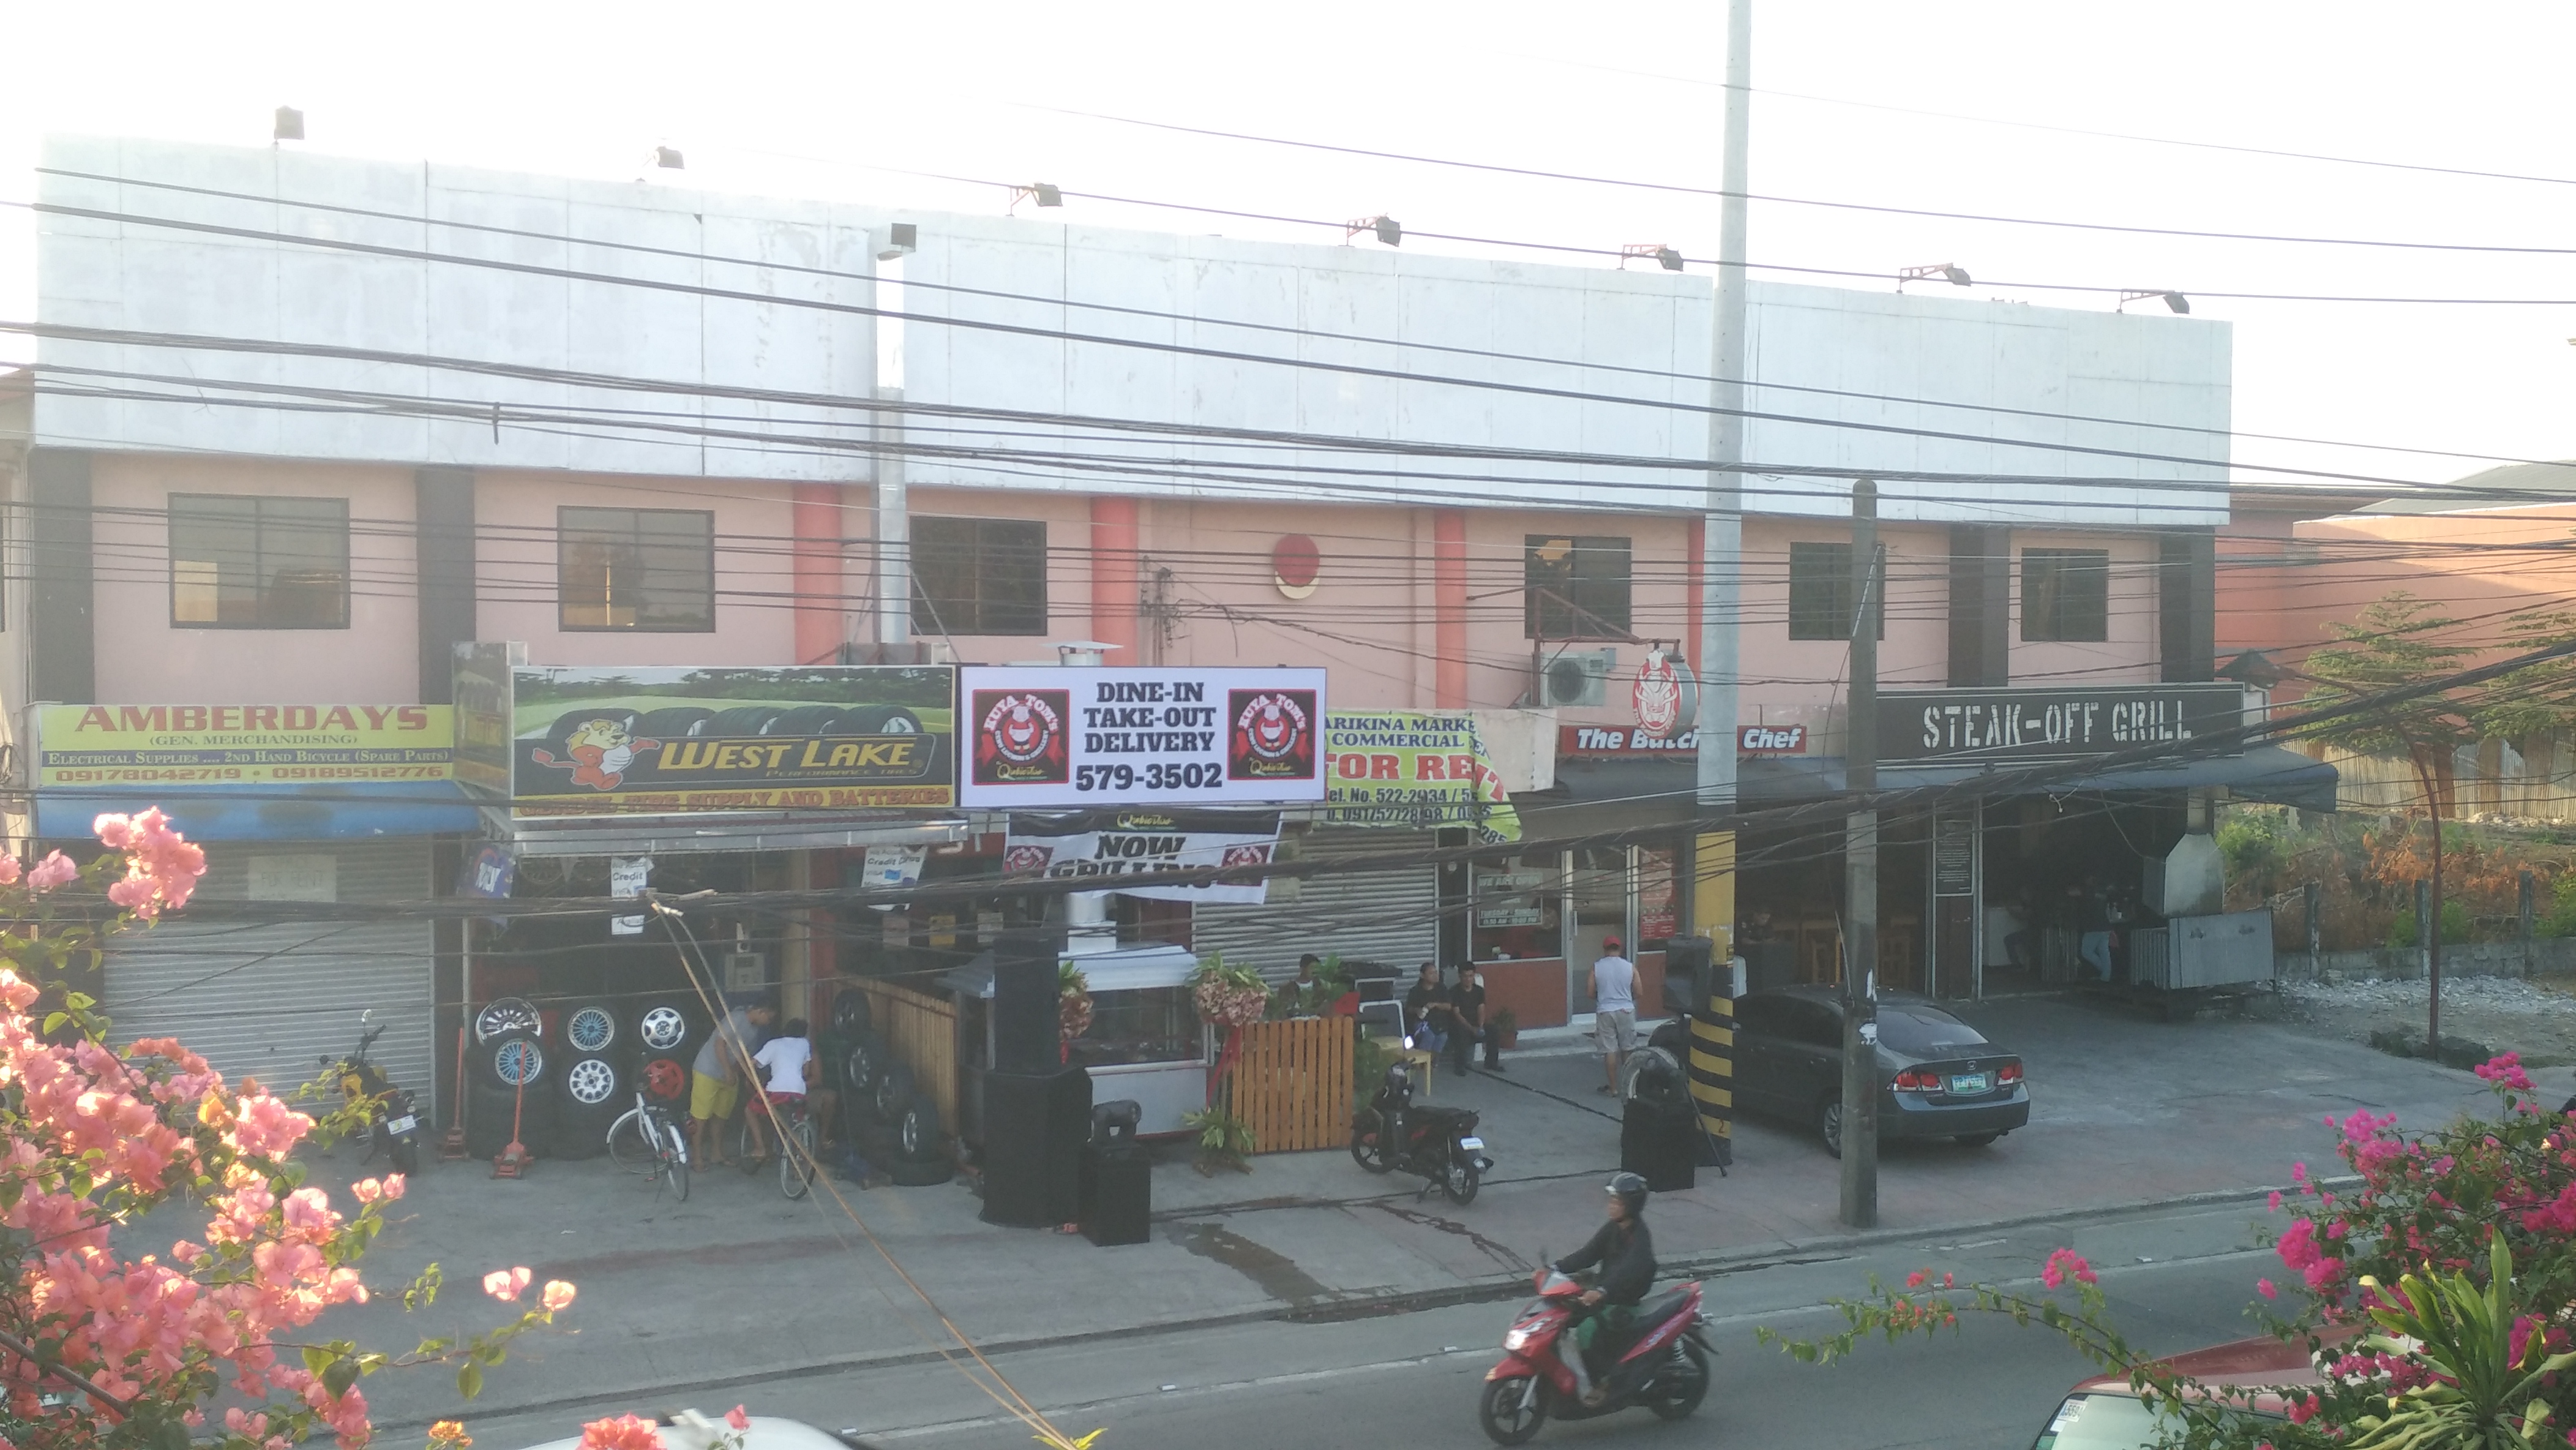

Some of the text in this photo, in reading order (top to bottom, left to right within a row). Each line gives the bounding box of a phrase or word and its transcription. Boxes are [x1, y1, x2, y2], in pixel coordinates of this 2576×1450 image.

[1096, 682, 1204, 702] DINE-IN
[75, 705, 427, 732] AMBERDAYS
[983, 695, 1019, 733] KUYA
[1083, 707, 1216, 727] TAKE-OUT
[1237, 694, 1271, 731] KUYA
[1922, 700, 2192, 748] STEAK-OFF GRILL
[149, 734, 358, 746] (GEN. MERCHANDISING)
[1084, 731, 1216, 753] DELIVERY
[1331, 732, 1465, 747] COMMERCIAL
[1577, 727, 1624, 750] The
[1742, 727, 1802, 750] Chef
[48, 753, 131, 765] ELECTRICAL
[135, 752, 198, 764] SUPPLIES
[224, 751, 250, 763] 2ND
[255, 750, 291, 762] HAND
[296, 750, 350, 762] BICYCLE
[355, 749, 399, 762] (SPARE
[405, 749, 448, 761] PARTS)
[657, 740, 915, 770] WEST LAKE
[56, 767, 444, 782] 09178042719 09189512776
[1075, 762, 1222, 791] 579-3502
[686, 792, 773, 810] SUPPLY
[776, 790, 823, 807] AND
[829, 788, 949, 806] BATTERIES
[1350, 787, 1372, 803] No.
[1376, 788, 1447, 803] 522-2934
[1094, 835, 1188, 860] NOW
[867, 857, 896, 866] Credit
[613, 872, 643, 881] Credit
